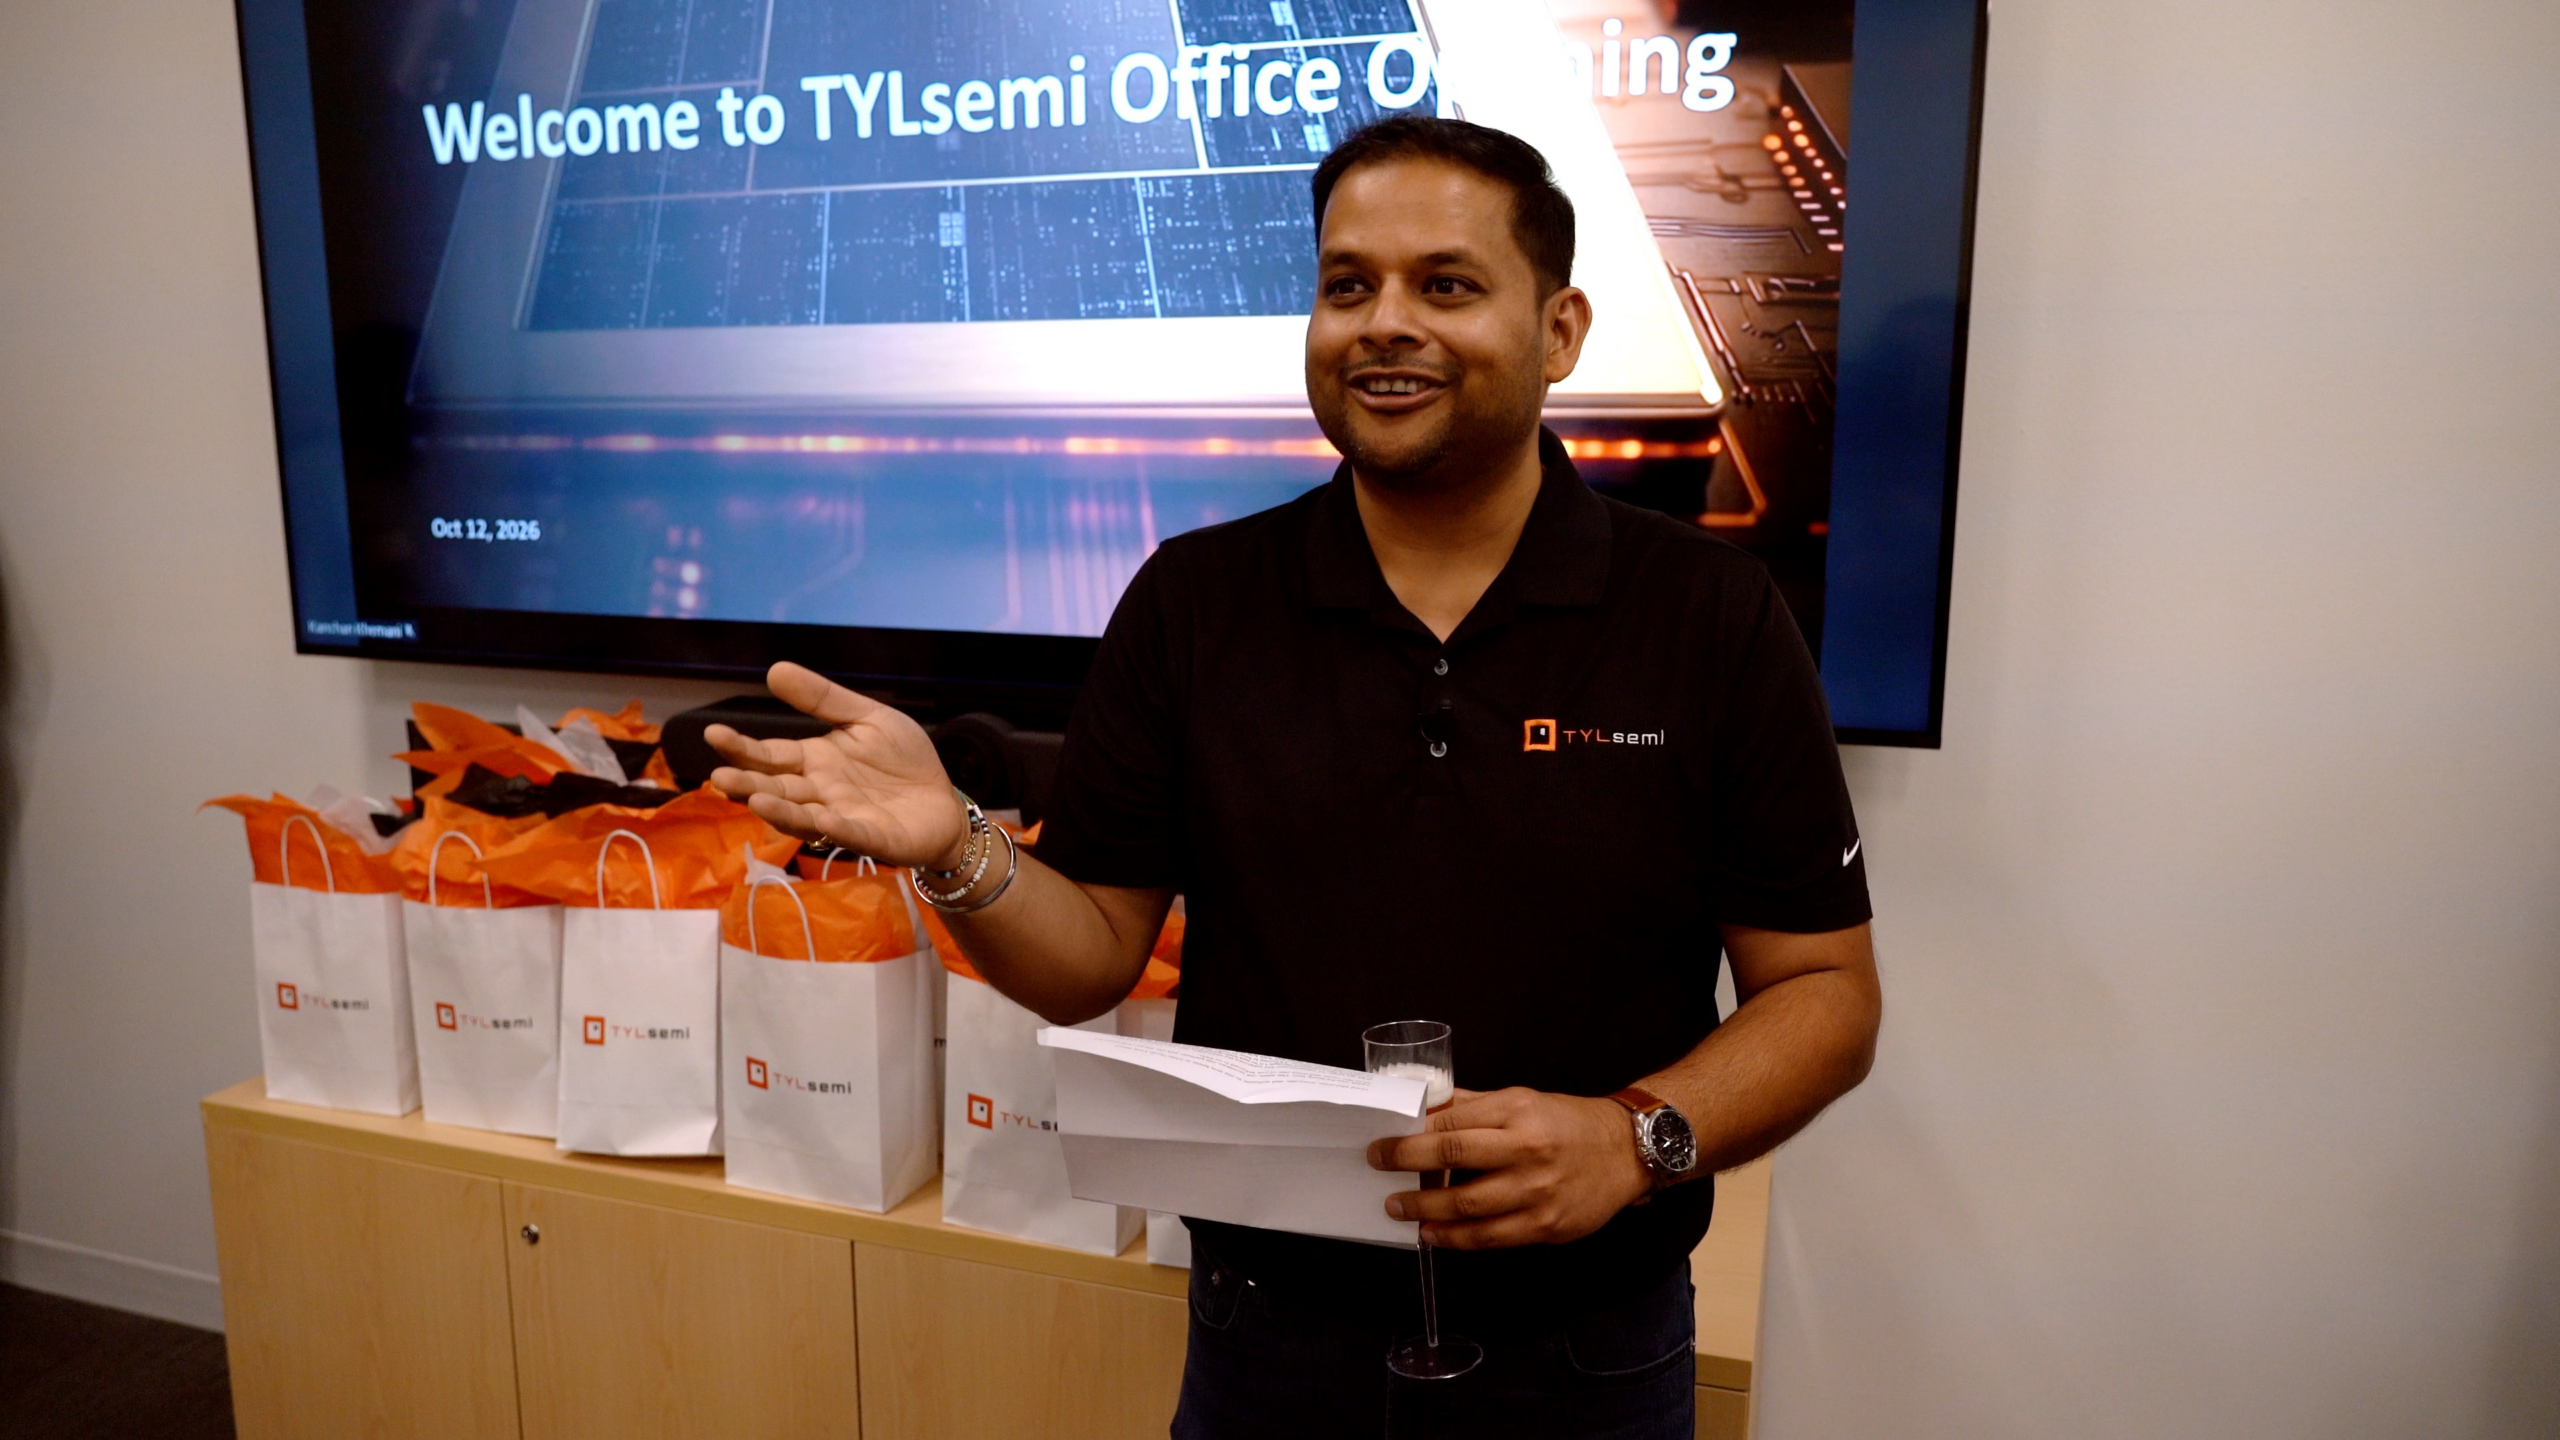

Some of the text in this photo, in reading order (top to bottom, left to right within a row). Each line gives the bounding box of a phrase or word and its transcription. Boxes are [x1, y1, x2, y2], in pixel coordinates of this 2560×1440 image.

[423, 18, 1738, 165] Welcome to TYLsemi Office Oning
[431, 517, 541, 543] Oct 12, 2026
[1562, 729, 1665, 745] TYLsemi
[302, 993, 370, 1011] TYLsemi
[460, 1013, 533, 1030] TYLsemi
[611, 1025, 691, 1040] TYLsemi
[773, 1072, 852, 1095] TYLsemi
